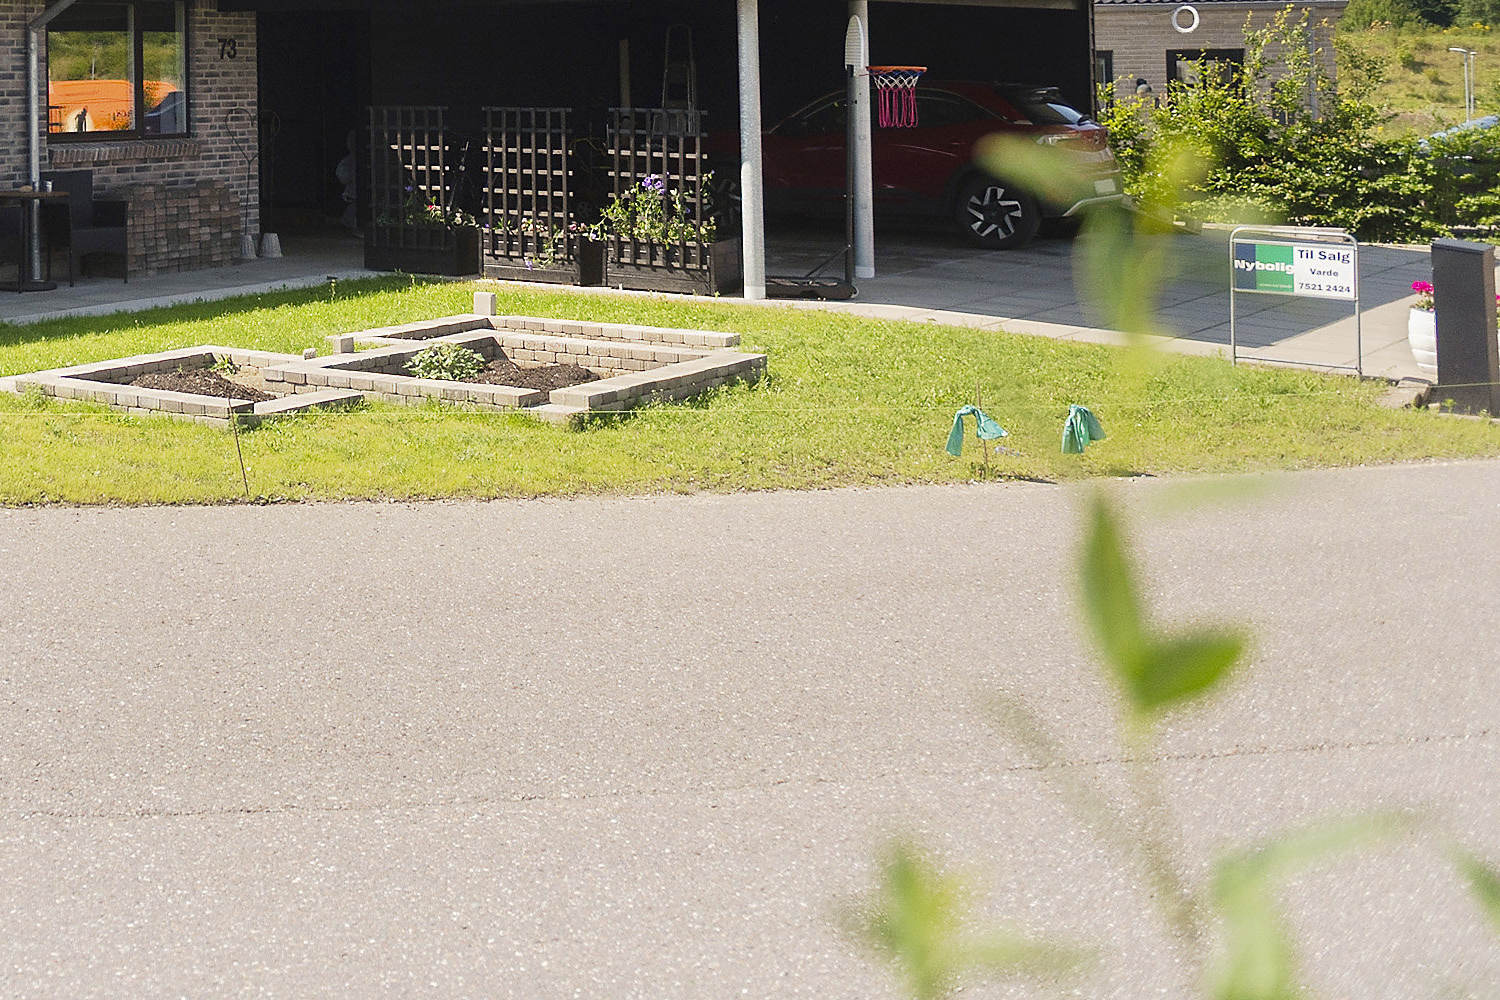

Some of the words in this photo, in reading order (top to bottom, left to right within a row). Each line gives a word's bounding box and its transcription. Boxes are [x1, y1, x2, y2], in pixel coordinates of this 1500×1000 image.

[217, 38, 237, 60] 73
[1298, 249, 1314, 260] Til
[1318, 250, 1350, 264] Salg
[1234, 259, 1294, 275] Nybolig
[1309, 268, 1339, 277] Varde
[1298, 282, 1322, 291] 7521
[1326, 284, 1351, 293] 2424
